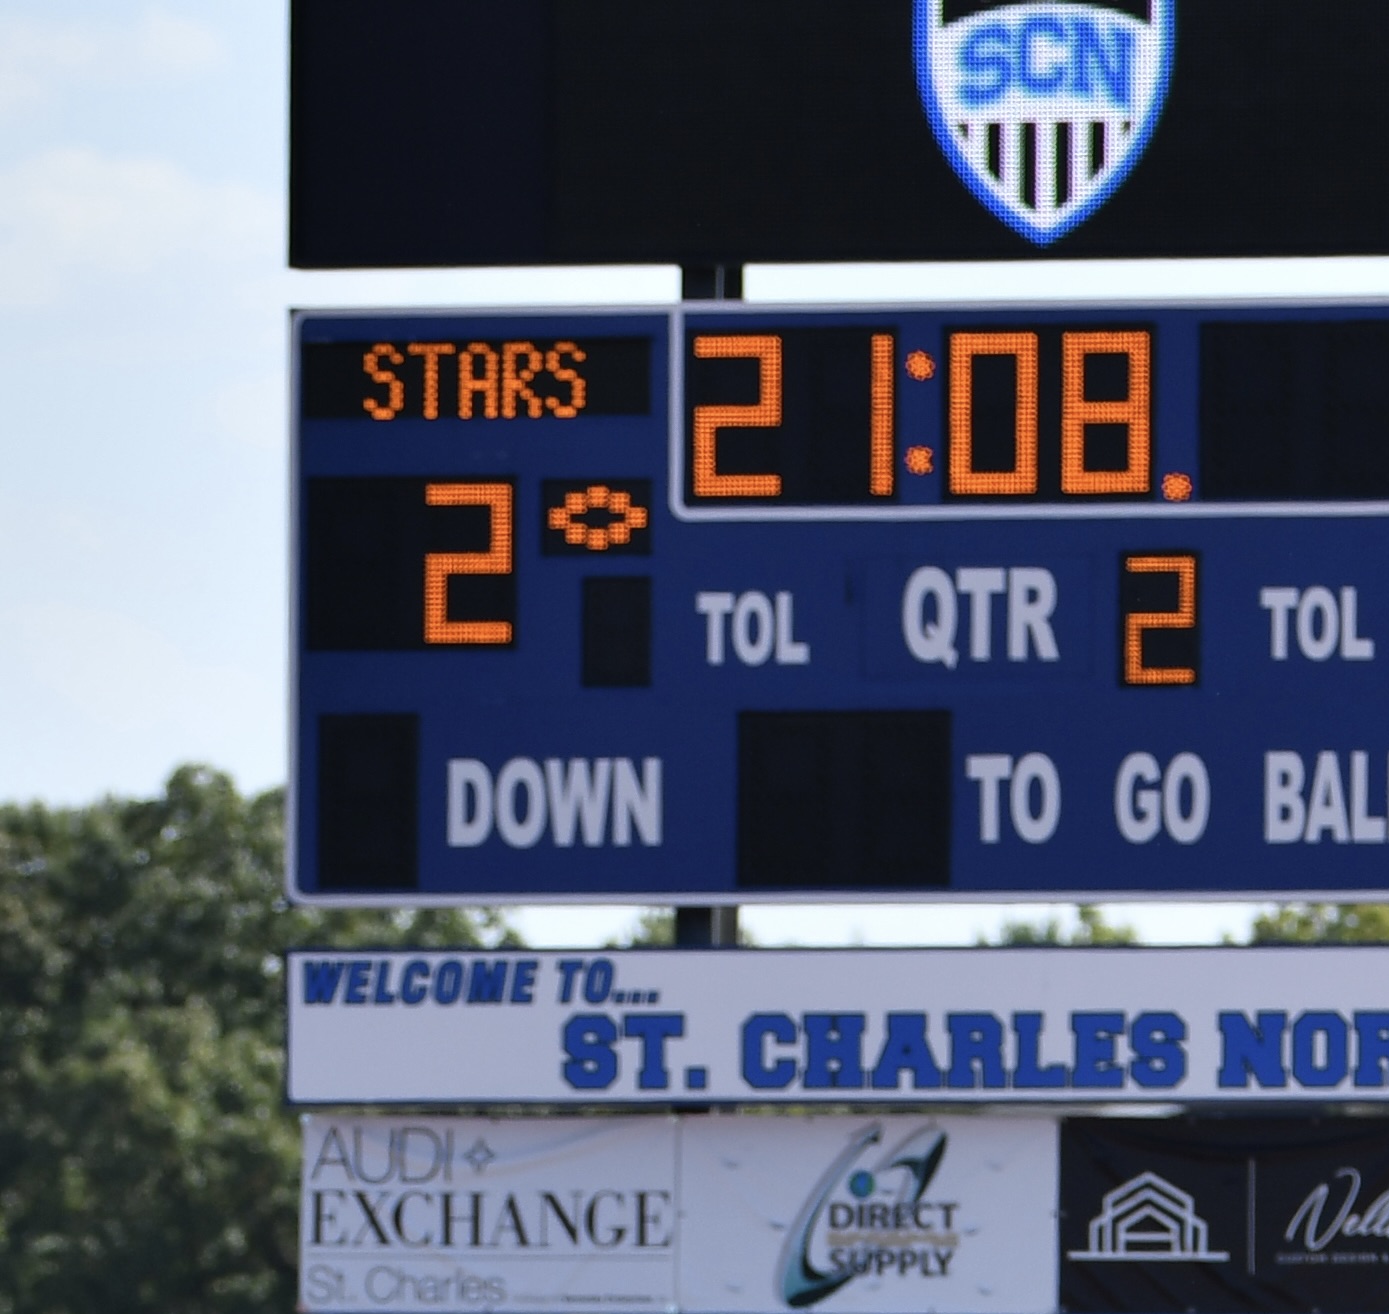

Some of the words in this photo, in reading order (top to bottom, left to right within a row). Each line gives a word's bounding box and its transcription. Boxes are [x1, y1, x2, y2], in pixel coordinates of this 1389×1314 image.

[957, 14, 1131, 112] SCN
[362, 342, 587, 421] STARS
[424, 483, 513, 645] 2
[697, 592, 809, 666] TOL
[903, 566, 1059, 669] QTR
[1125, 556, 1196, 685] 2
[1261, 587, 1374, 660] TOL
[446, 757, 662, 847] DOWN
[966, 752, 1061, 844] TO
[1115, 752, 1211, 844] GO
[303, 959, 538, 1005] WELCOME
[556, 959, 660, 1005] TO...
[560, 1013, 709, 1090] ST.
[741, 1011, 1187, 1089] CHARLES
[311, 1127, 454, 1185] AUDI
[309, 1190, 673, 1247] EXCHANGE
[829, 1203, 958, 1230] DIRECT
[364, 1264, 507, 1303] Charles
[829, 1248, 953, 1277] SUPPLY
